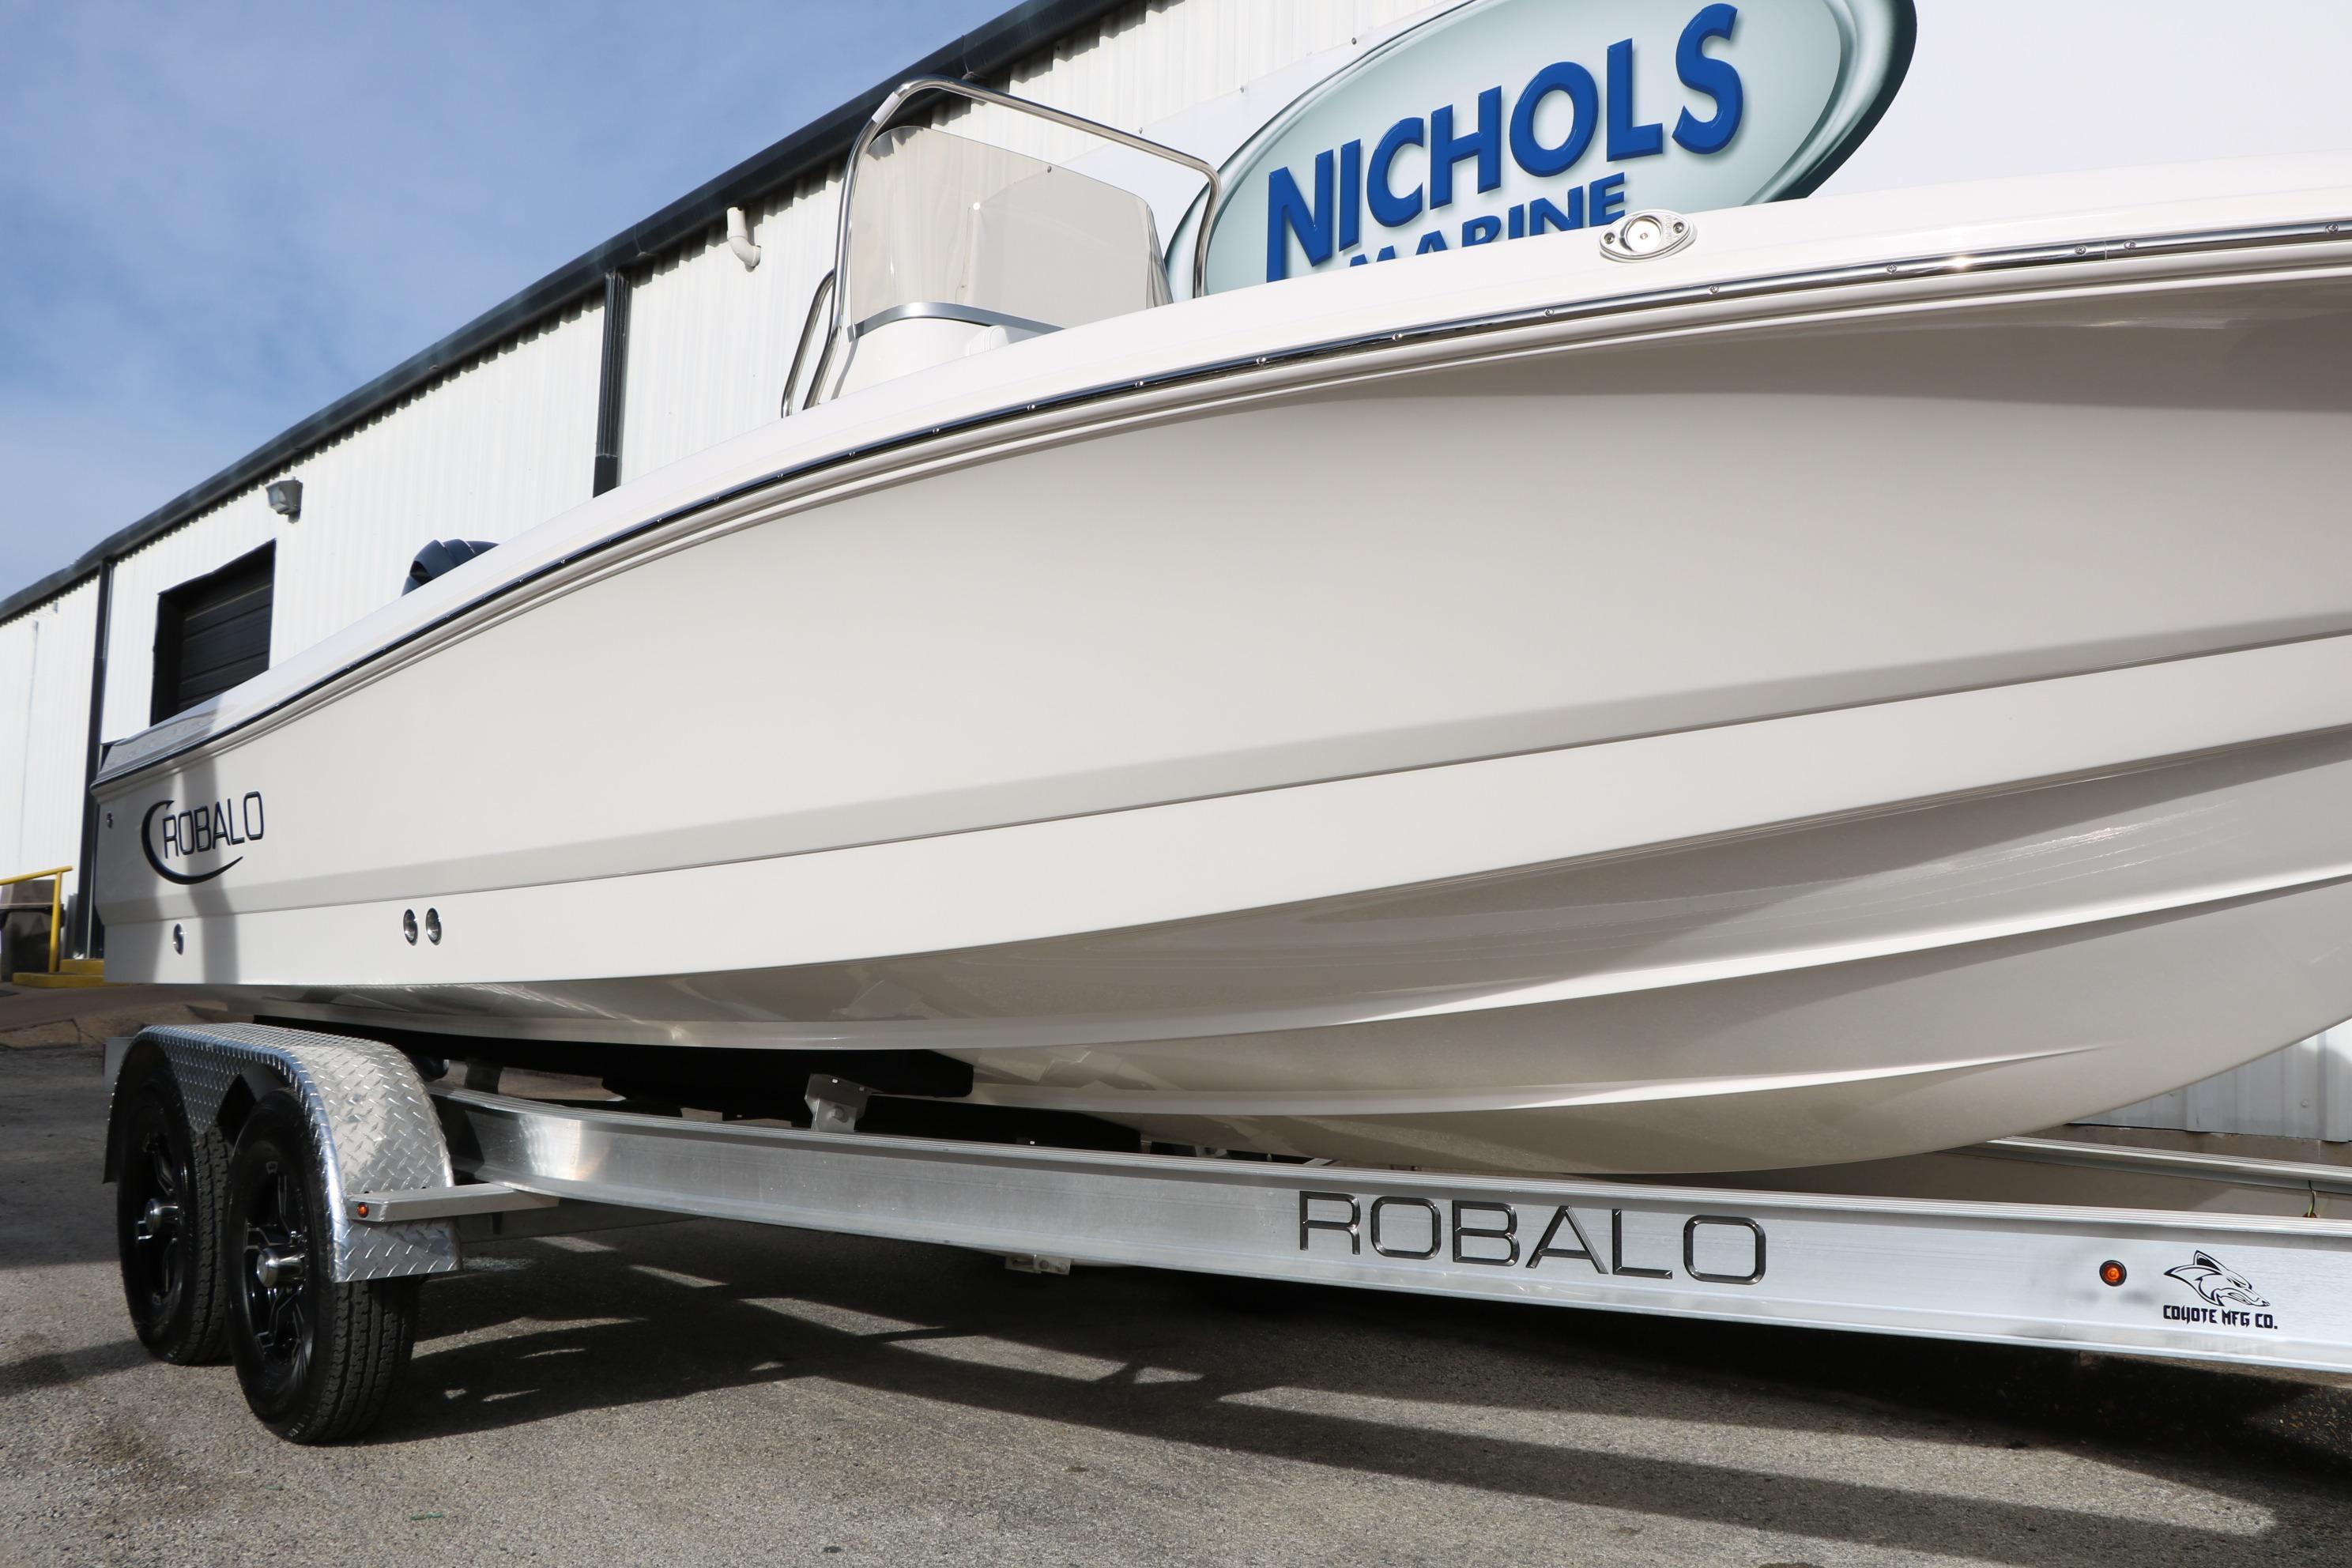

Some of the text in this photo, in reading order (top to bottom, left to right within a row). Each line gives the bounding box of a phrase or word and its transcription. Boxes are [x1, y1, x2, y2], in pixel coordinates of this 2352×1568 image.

[1266, 2, 1743, 283] NICHOLS
[162, 791, 264, 859] ROBALO
[1299, 1190, 1766, 1285] ROBALO
[2163, 1305, 2278, 1329] COYOTE MFG CO.
